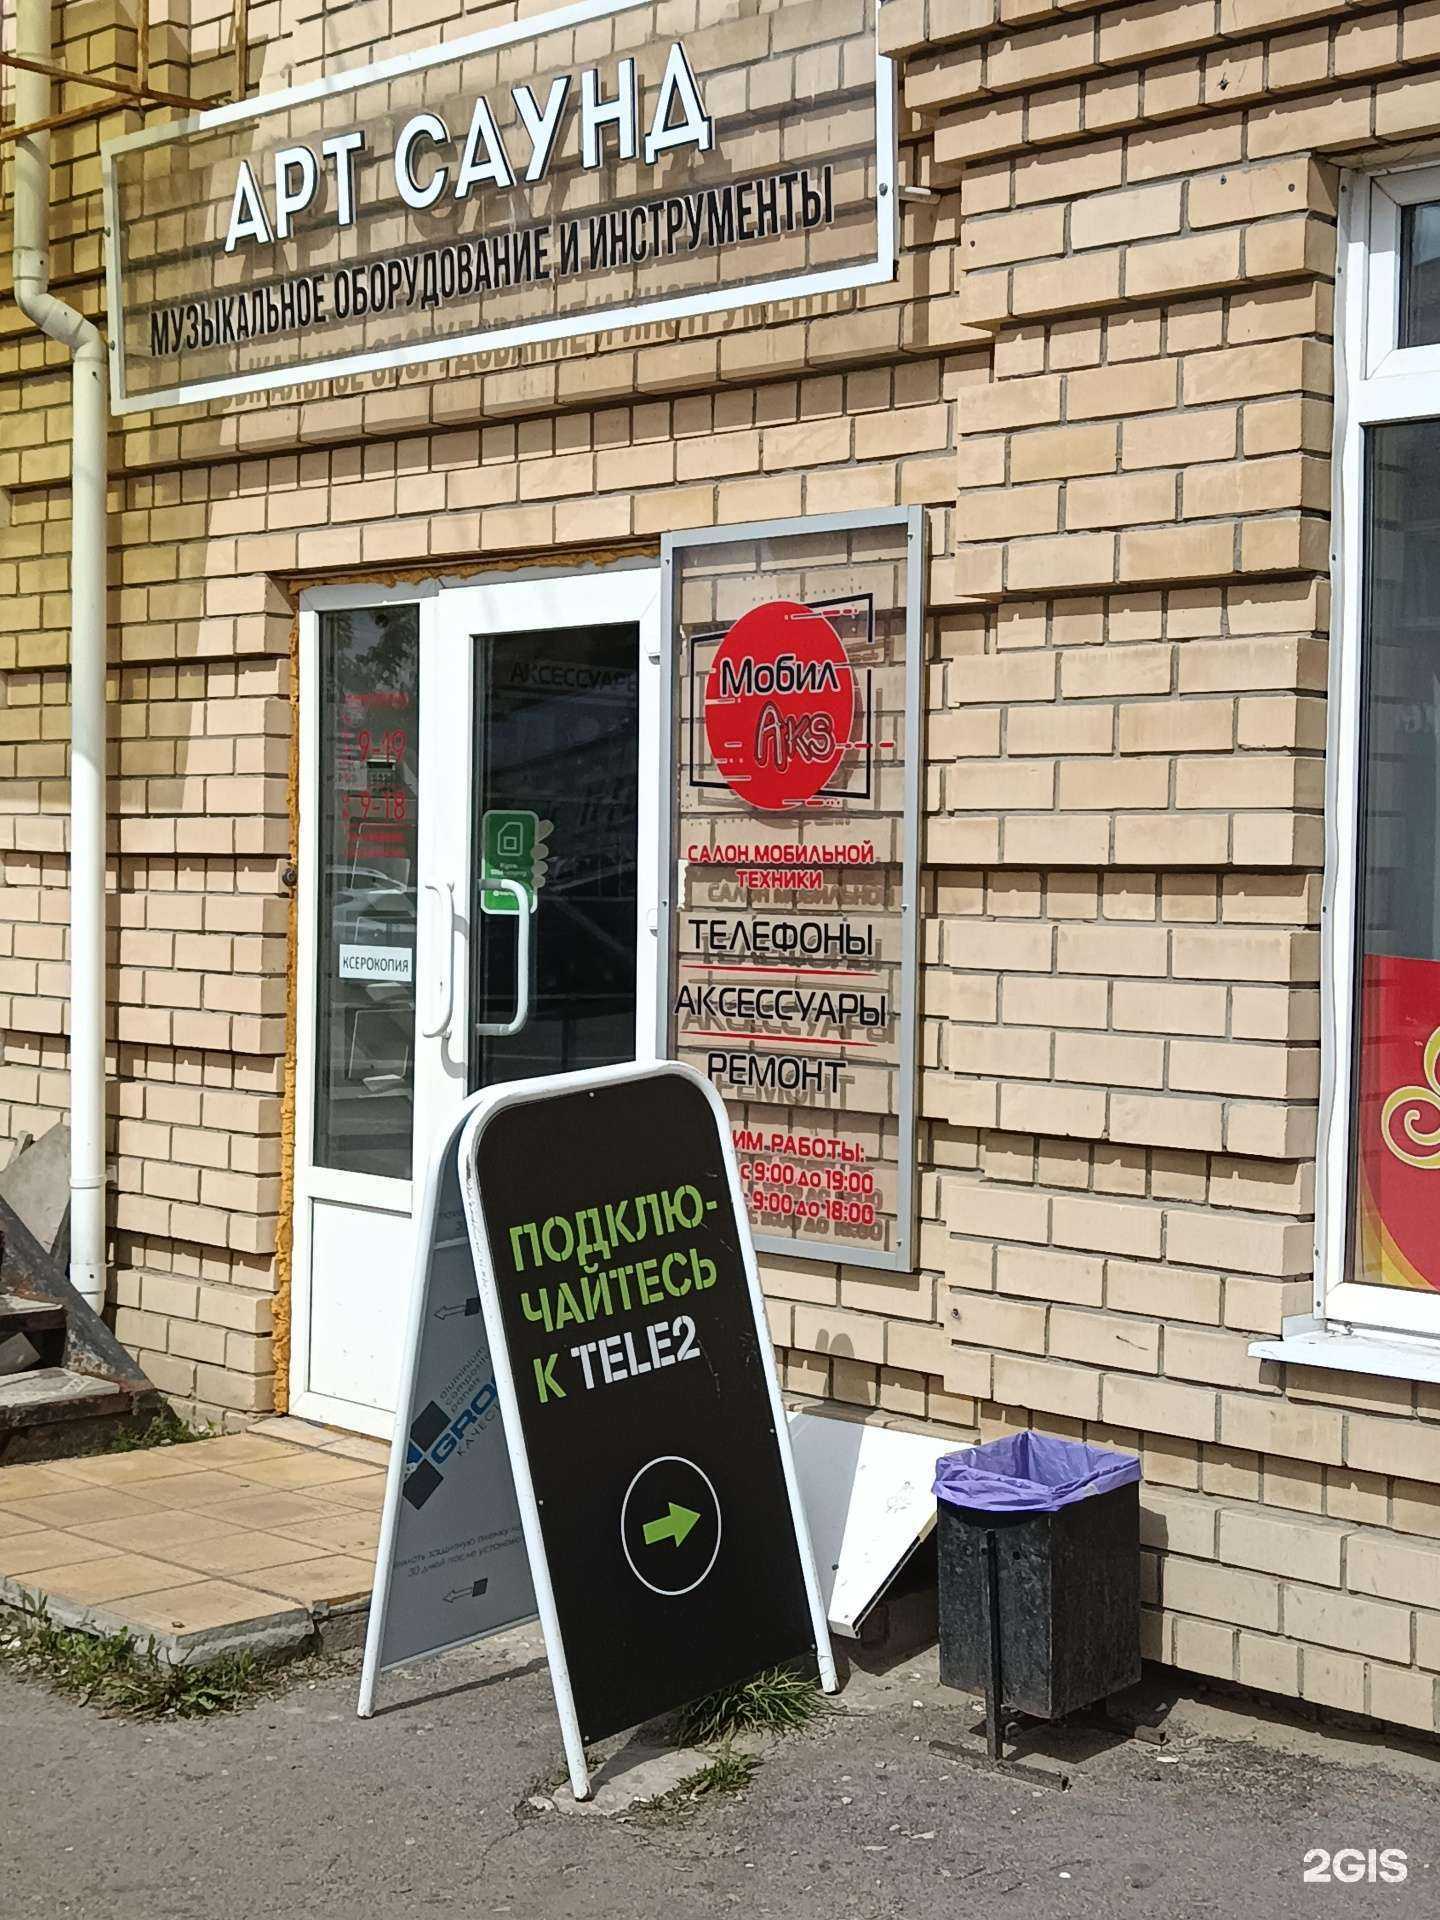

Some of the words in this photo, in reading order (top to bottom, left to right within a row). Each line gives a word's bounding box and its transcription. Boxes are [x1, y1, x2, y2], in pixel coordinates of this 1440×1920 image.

[224, 130, 365, 253] АРТ
[395, 41, 715, 210] САУНД
[150, 273, 328, 357] МУЗЫКАЛЬНОЕ
[334, 226, 550, 319] ОБОРУДОВАНИЕ
[560, 219, 581, 276] И
[589, 165, 833, 271] ИНСТРУМЕНТЫ
[721, 655, 840, 697] Мобил
[358, 730, 407, 762] 9-19
[360, 790, 406, 820] 9-18
[688, 845, 749, 862] САЛОН
[754, 840, 873, 863] МОБИЛЬНОЙ
[736, 870, 823, 889] ТЕХНИКИ
[688, 919, 873, 956] ТЕЛЕФОНЫ
[343, 956, 409, 972] КСЕРОКОПИЯ
[675, 985, 886, 1027] АКСЕССУАРЫ
[707, 1053, 846, 1094] РЕМОНТ
[732, 1130, 763, 1151] ИМ
[771, 1133, 865, 1163] РАБОТЫ:
[754, 1162, 794, 1185] 9:00
[797, 1171, 821, 1188] до
[825, 1170, 874, 1194] 19:00
[509, 1184, 718, 1272] ПОДКЛЮ-
[752, 1191, 793, 1215] 9:00
[796, 1201, 820, 1218] до
[826, 1200, 875, 1226] 18:00
[520, 1248, 718, 1333] ЧАЙТЕСЬ
[533, 1353, 567, 1404] К
[570, 1315, 701, 1390] TELE2
[431, 1377, 498, 1464] GRO
